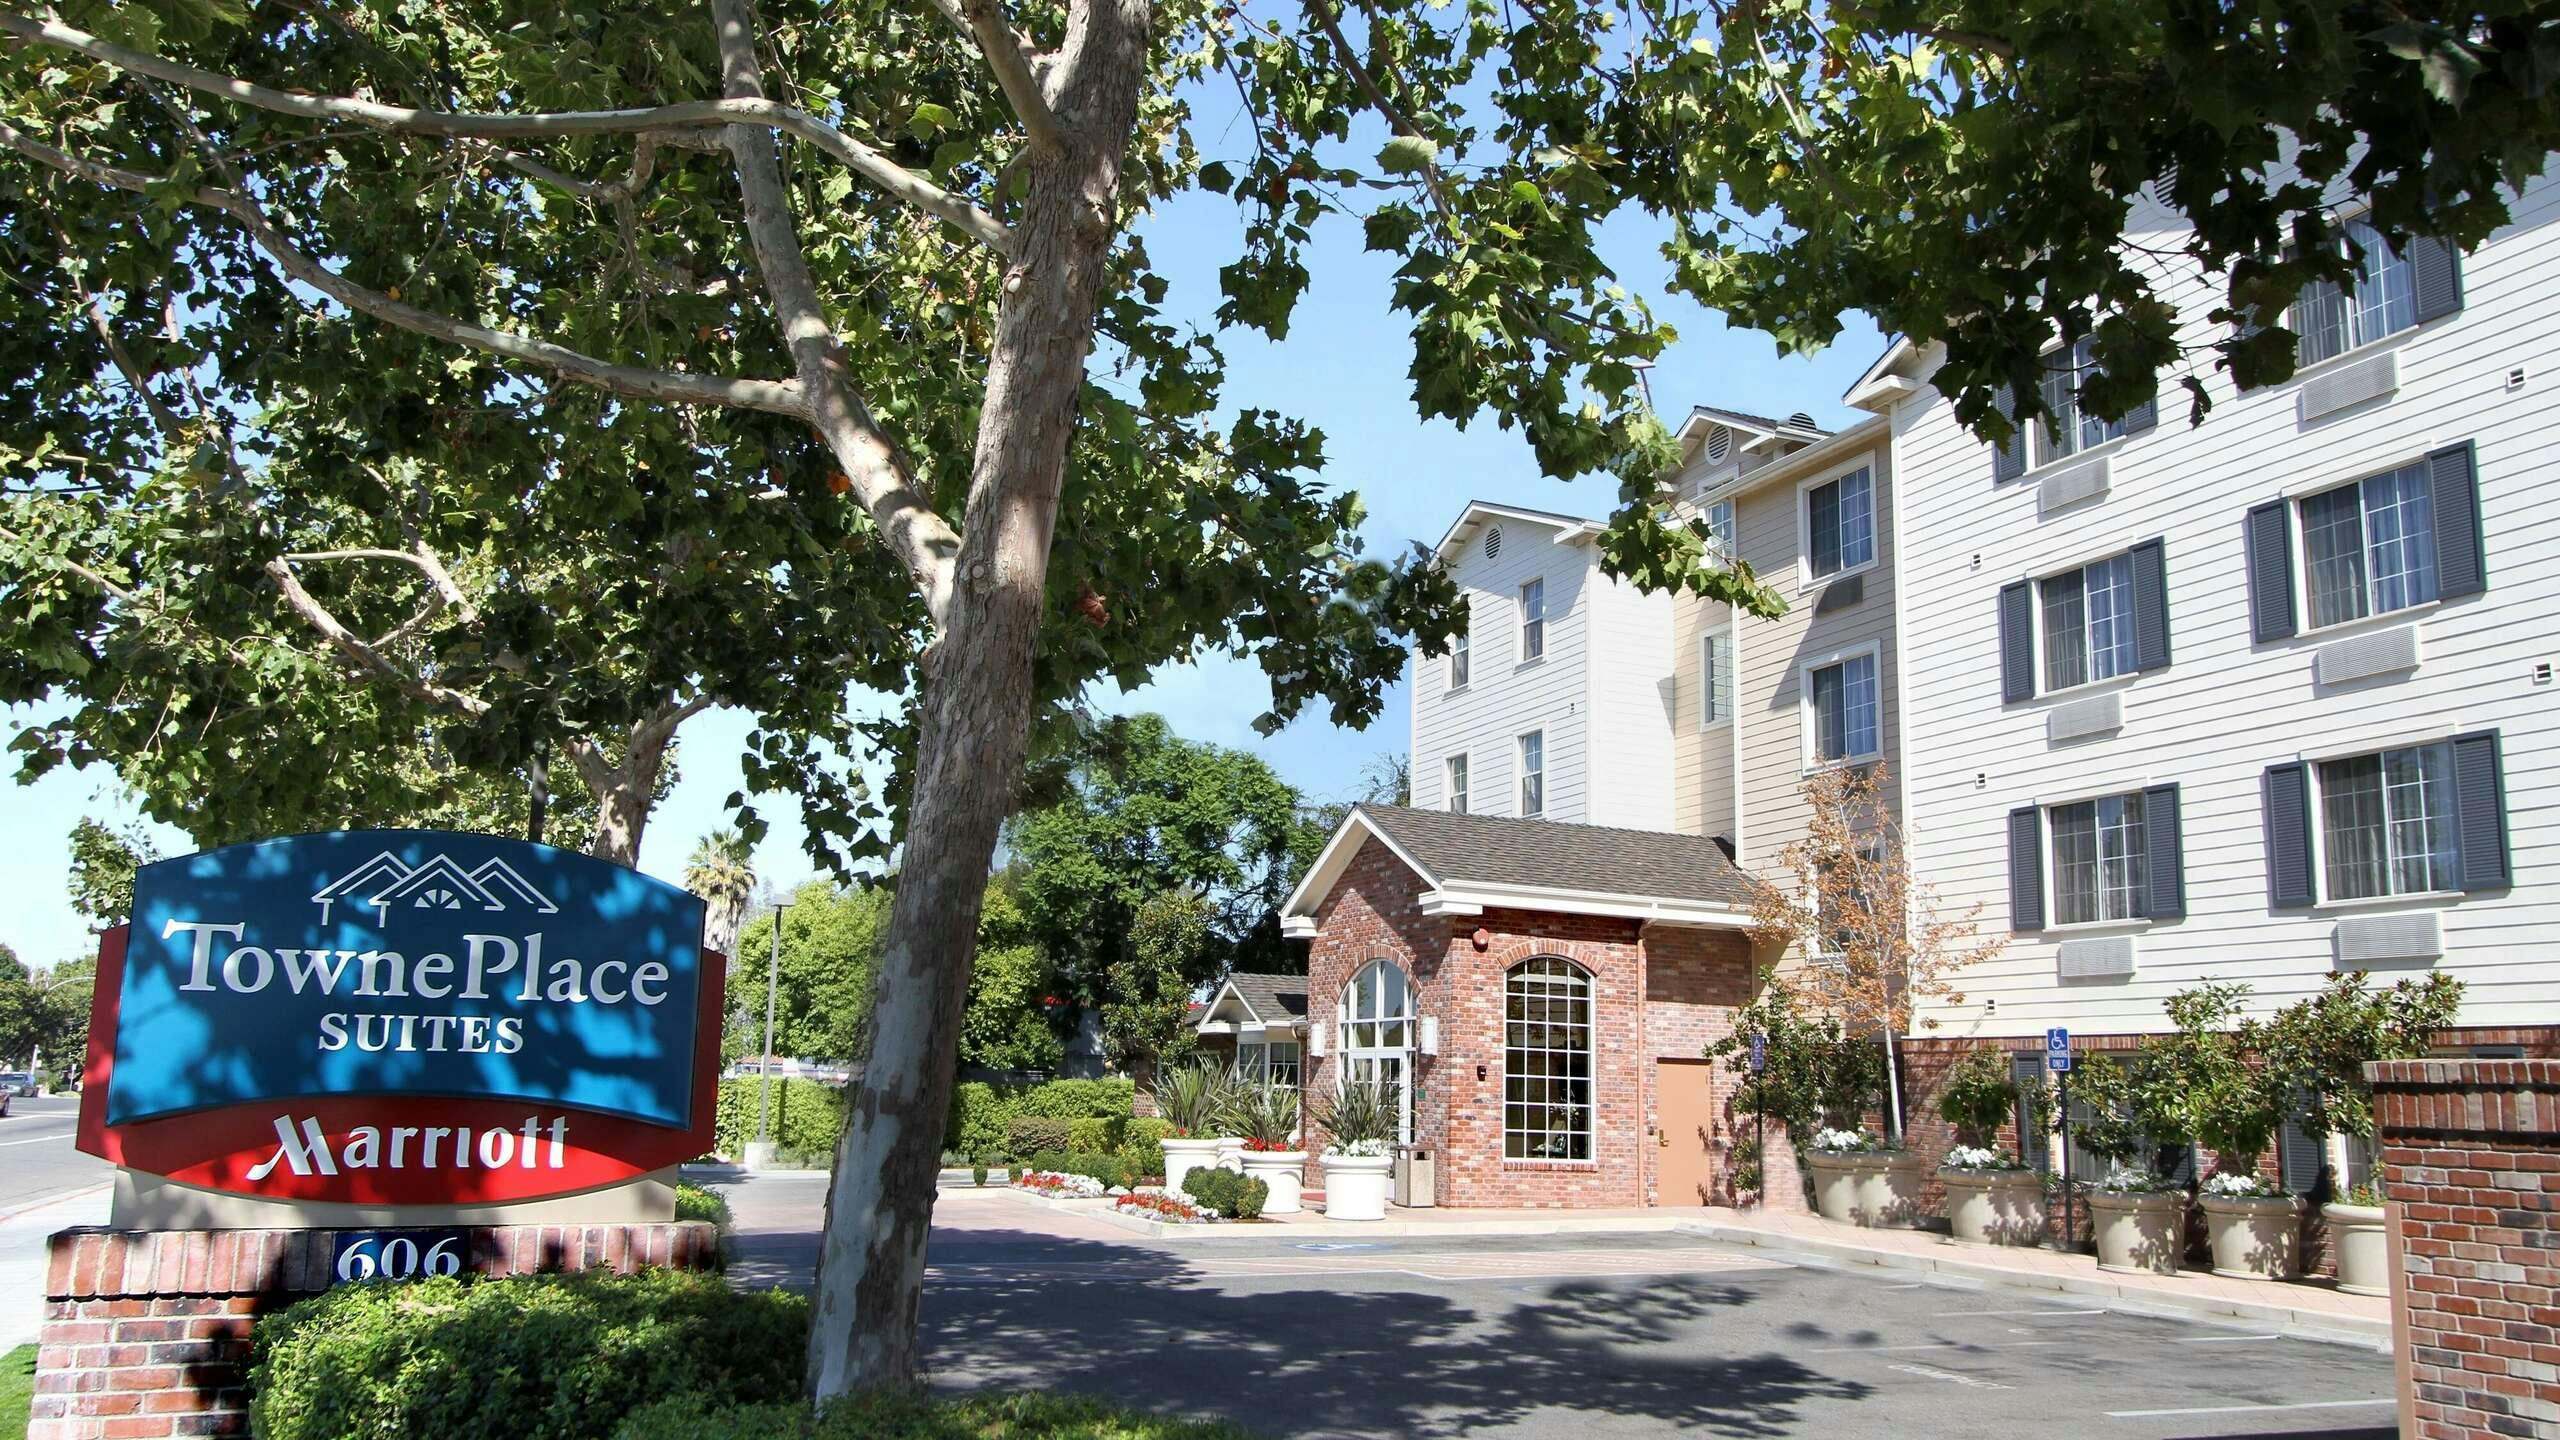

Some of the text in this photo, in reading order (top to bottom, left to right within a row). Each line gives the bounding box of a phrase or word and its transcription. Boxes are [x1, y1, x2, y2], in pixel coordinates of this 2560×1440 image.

[161, 918, 670, 1006] TownePlace
[317, 1012, 525, 1054] SUITES
[245, 1113, 571, 1181] Marriott
[337, 1236, 461, 1281] 606
